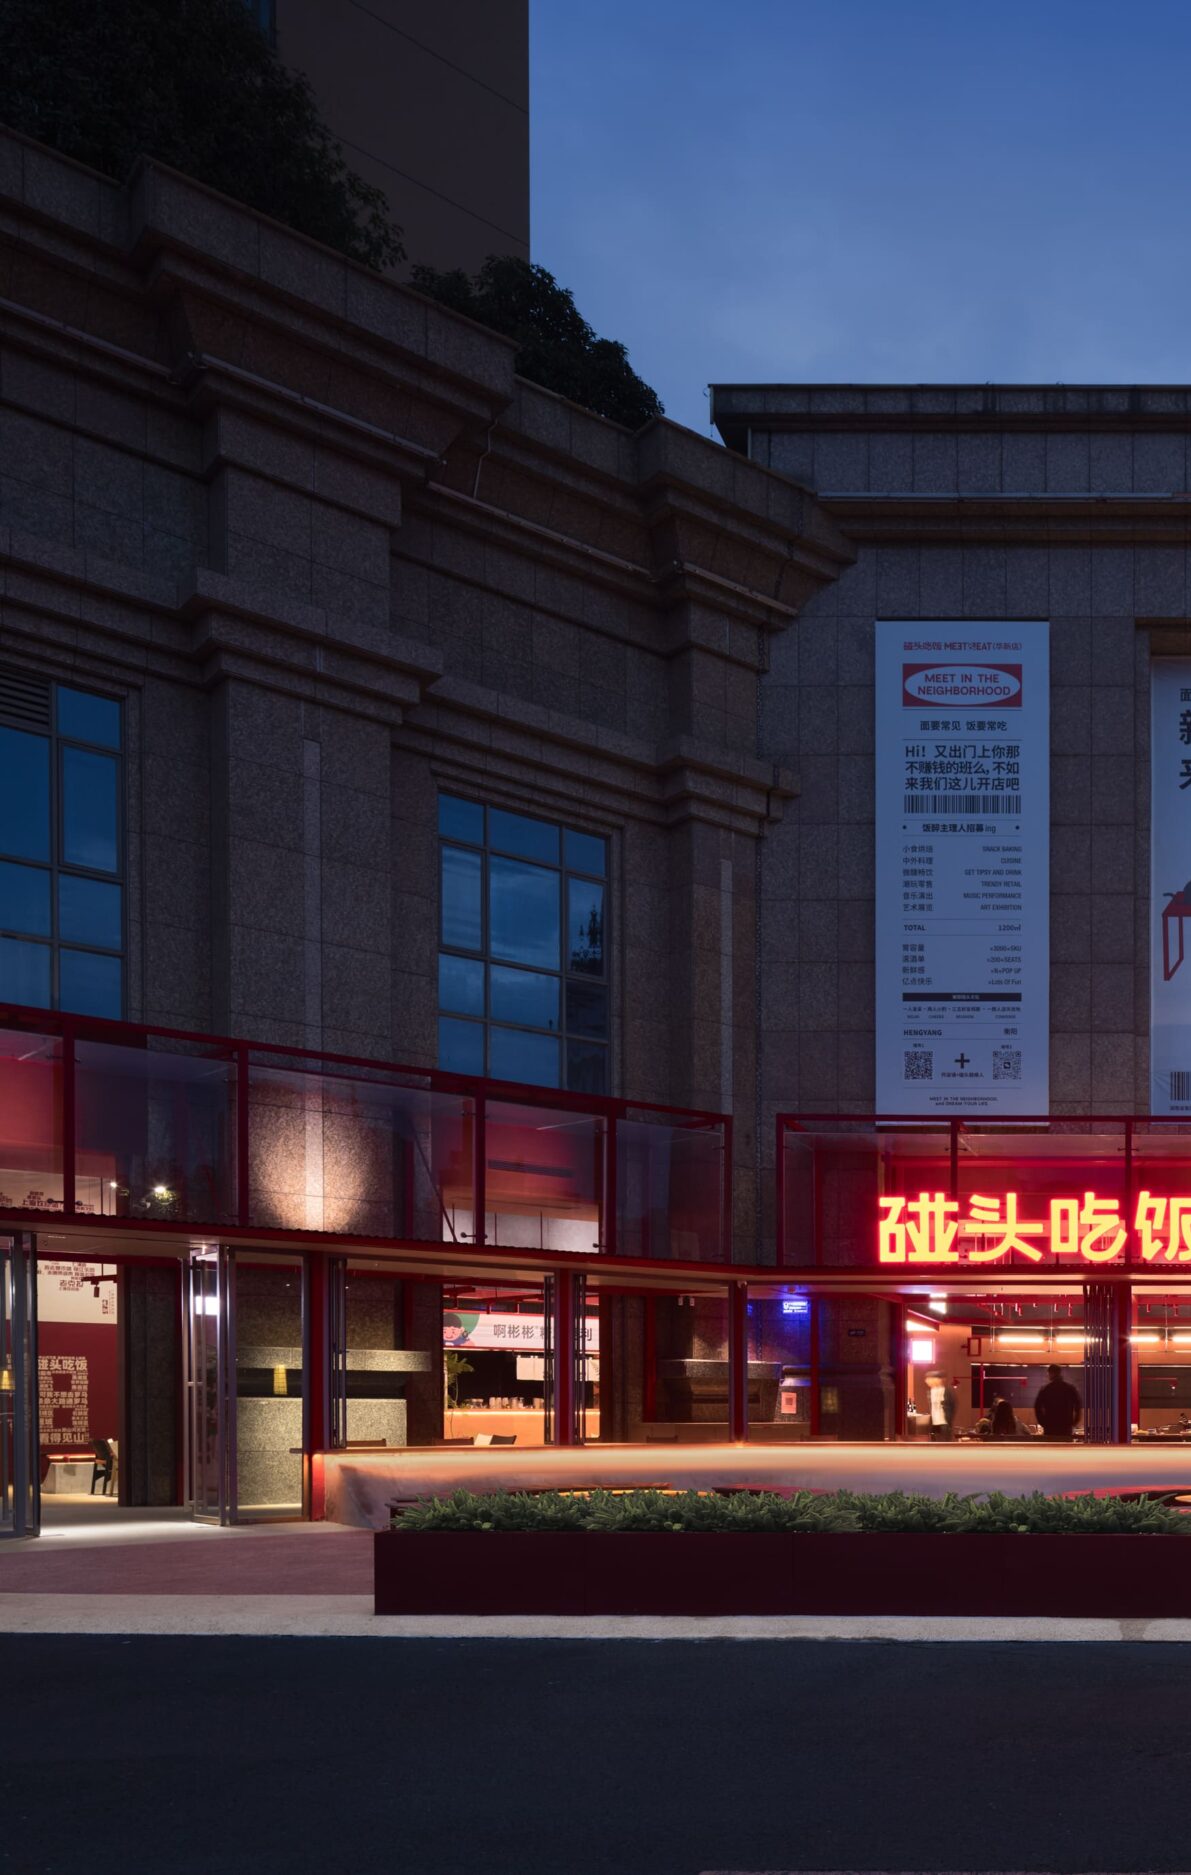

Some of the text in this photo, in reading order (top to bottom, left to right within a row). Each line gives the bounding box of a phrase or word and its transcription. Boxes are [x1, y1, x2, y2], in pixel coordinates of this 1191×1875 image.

[925, 673, 1000, 683] MEET IN THE
[917, 686, 1011, 696] NEIGHBORHOOD
[920, 721, 1007, 732] 面要常见 饭要常吃
[905, 777, 1020, 791] 来我们这儿开店吧
[493, 1324, 535, 1339] 啊彬彬
